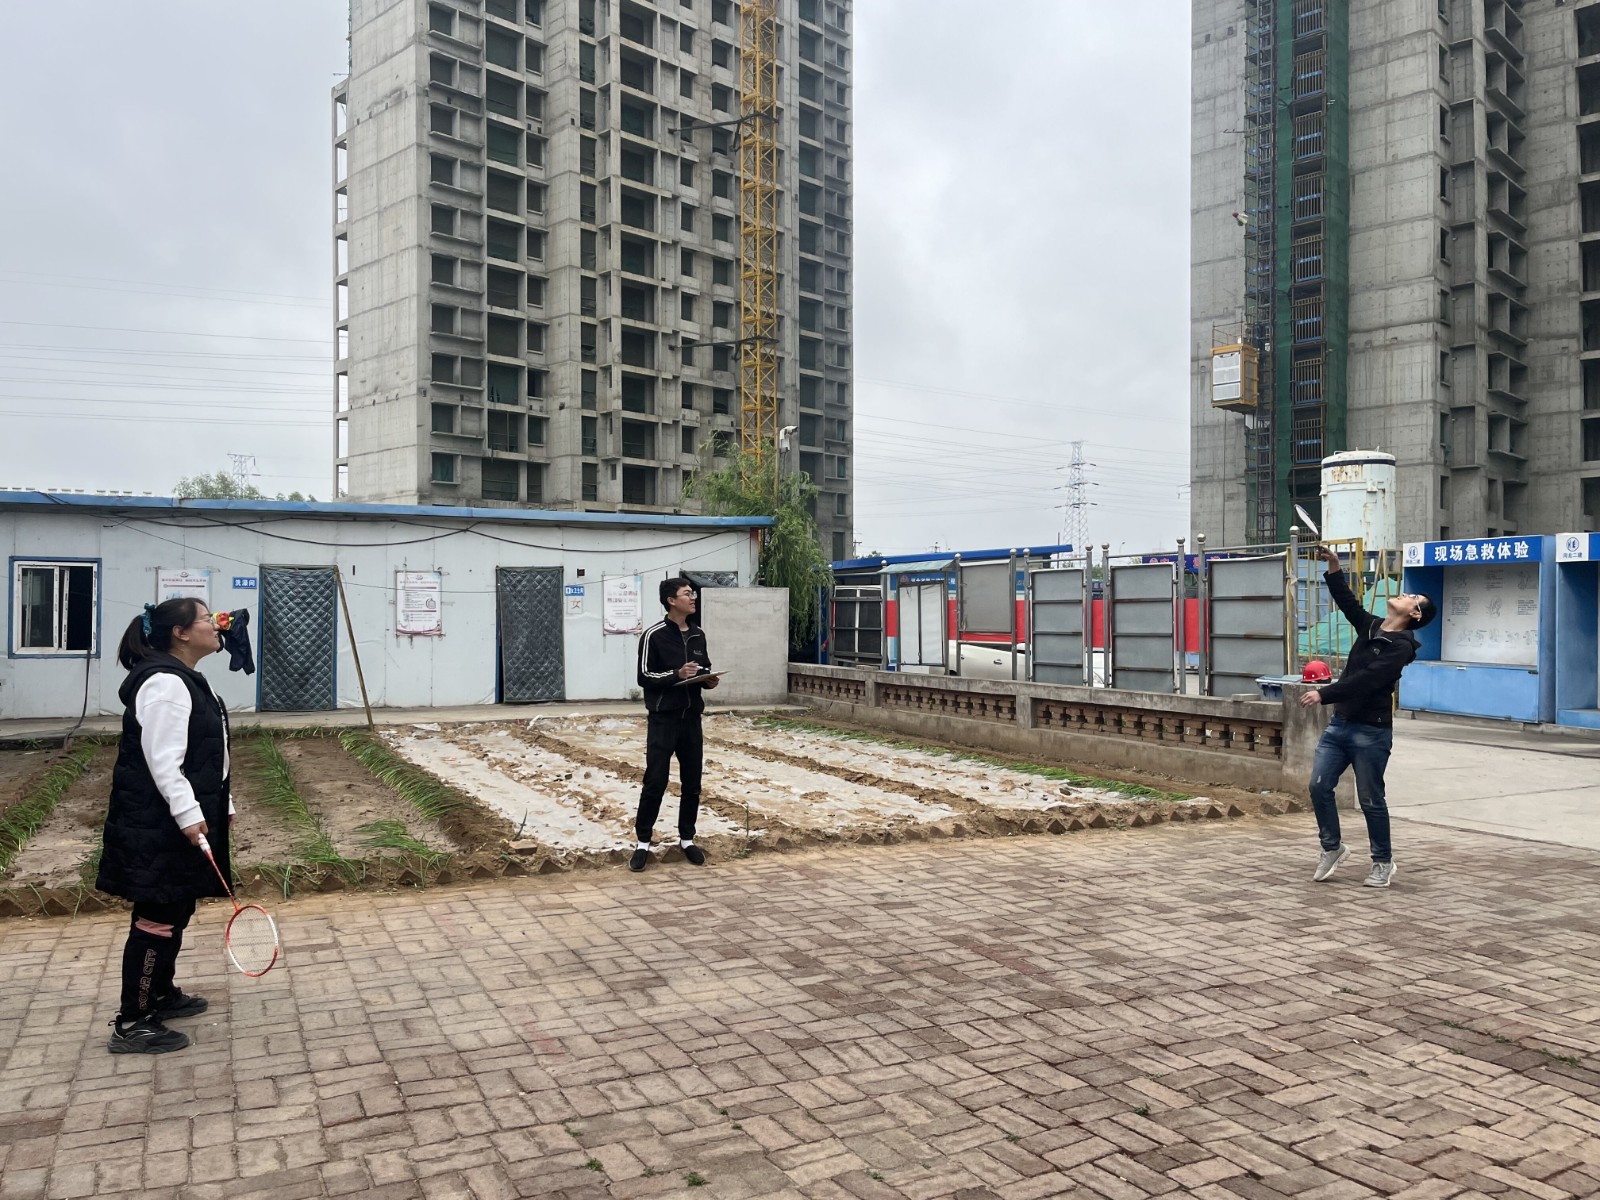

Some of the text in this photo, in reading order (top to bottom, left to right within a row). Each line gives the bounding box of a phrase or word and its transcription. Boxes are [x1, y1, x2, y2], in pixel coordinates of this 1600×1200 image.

[1434, 540, 1529, 562] 现场急救体验
[143, 948, 157, 975] CITY
